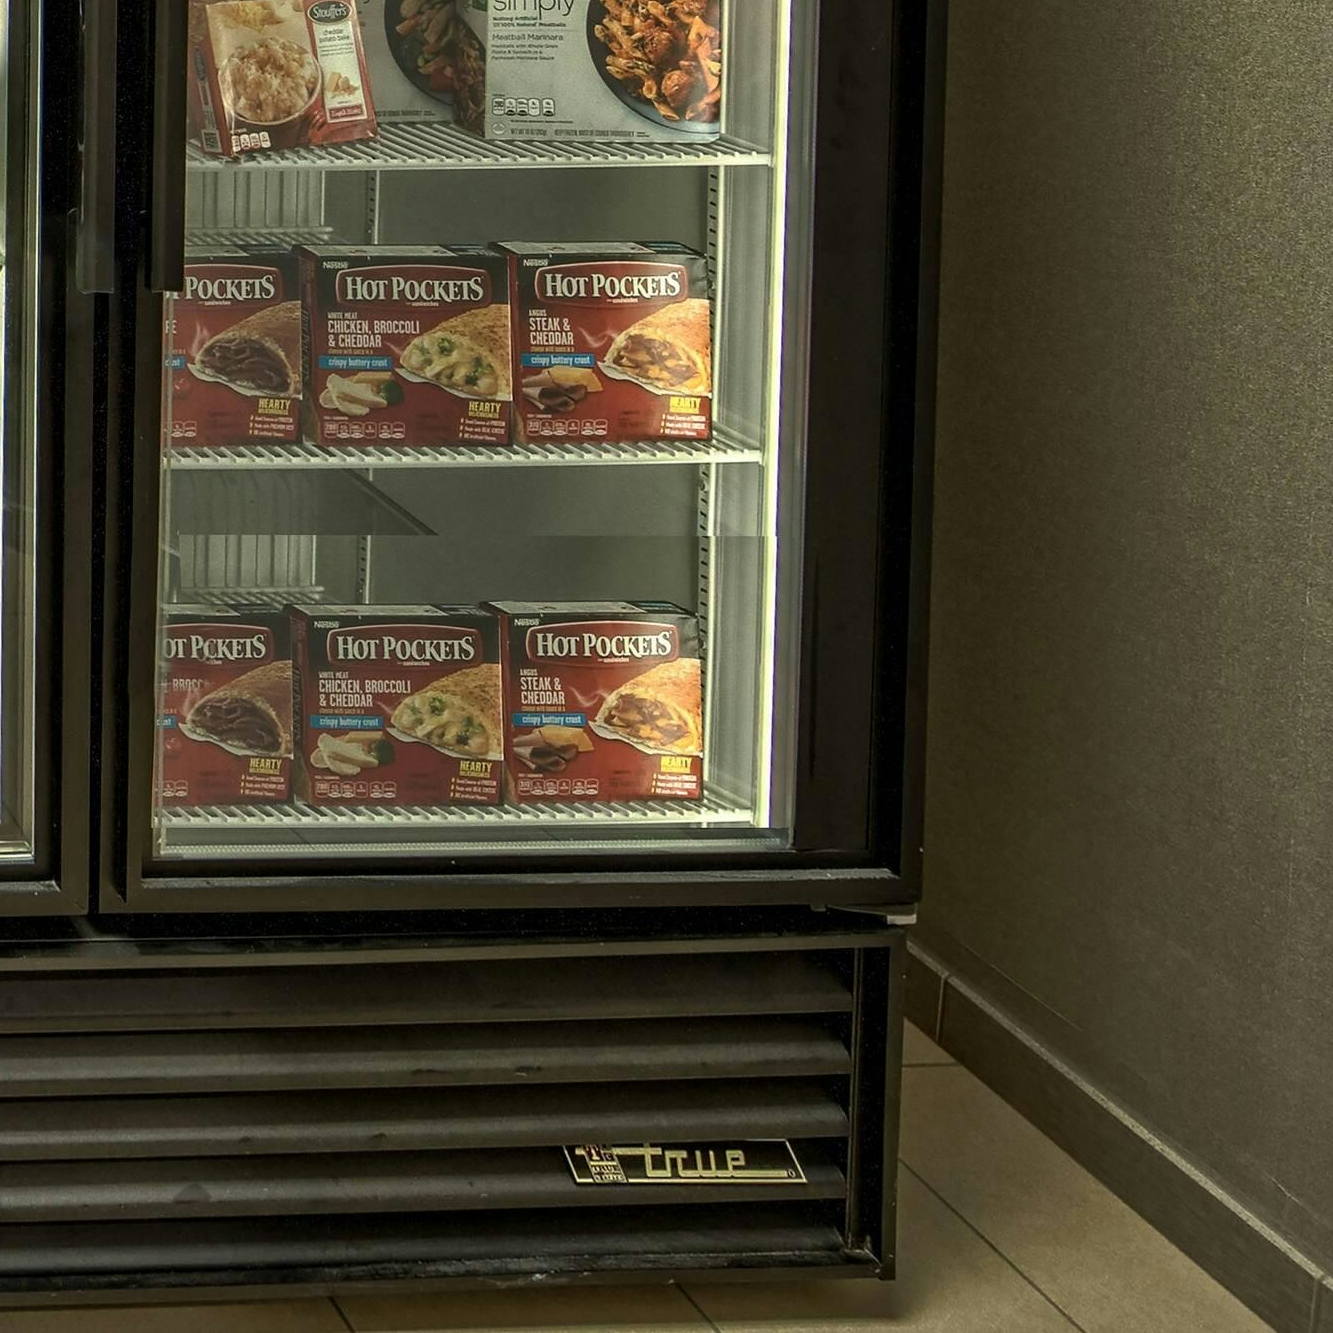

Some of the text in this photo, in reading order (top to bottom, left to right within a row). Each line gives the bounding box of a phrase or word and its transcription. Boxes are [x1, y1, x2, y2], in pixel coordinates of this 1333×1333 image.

[312, 3, 348, 20] Stouffer's
[493, 33, 564, 41] Meatball Marinara
[184, 274, 276, 301] POCKETS
[345, 276, 483, 302] HOT POCKETS
[545, 272, 681, 299] HOT POCKETS
[328, 320, 420, 334] CHICKEN, BROCCOLI
[529, 318, 571, 331] STEAK &
[328, 335, 382, 347] & CHEDDAR
[530, 333, 574, 345] CHEDDAR
[328, 356, 388, 368] crispy buttery crust
[531, 355, 590, 366] crispy buttery crust
[258, 399, 291, 410] HEARTY
[469, 401, 501, 413] HEARTY
[670, 397, 701, 409] HEARTY
[336, 636, 475, 661] HOT POCKETS
[536, 632, 672, 658] HOT POCKETS
[318, 680, 411, 694] CHICKEN, BROCCOLI
[520, 678, 562, 690] STEAK &
[319, 694, 373, 707] & CHEDDAR
[521, 692, 565, 705] CHEDDAR
[319, 716, 379, 727] crispy buttery crust
[522, 714, 581, 725] crispy buttery crust
[249, 758, 282, 769] HEARTY
[460, 761, 493, 772] HEARTY
[660, 756, 692, 769] HEARTY
